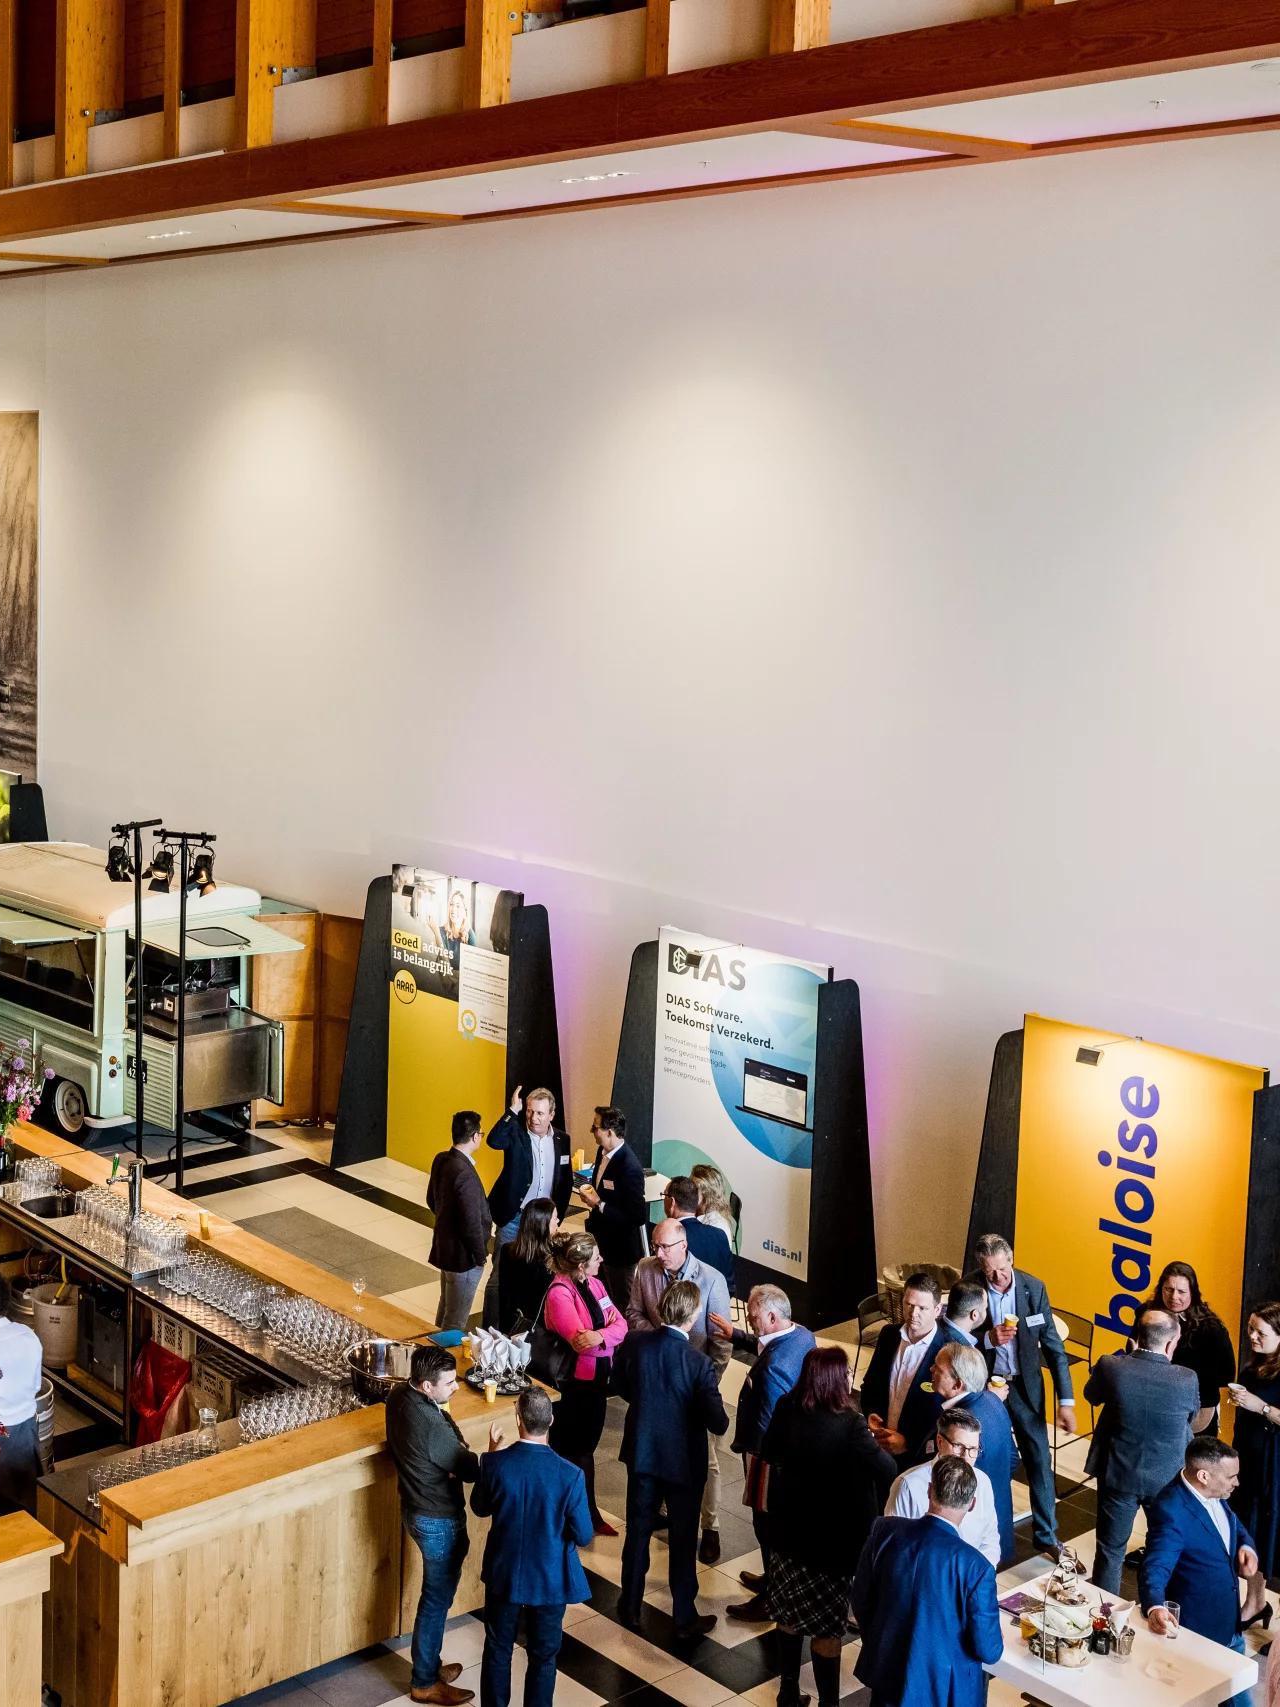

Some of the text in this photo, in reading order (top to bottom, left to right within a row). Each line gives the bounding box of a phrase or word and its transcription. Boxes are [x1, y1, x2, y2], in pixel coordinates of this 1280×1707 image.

[394, 931, 418, 949] Goed
[422, 942, 454, 960] advies
[393, 947, 402, 961] is
[403, 950, 454, 977] belangrijk
[396, 979, 414, 994] ARAG
[666, 993, 744, 1024] DIAS Software.
[665, 1009, 774, 1050] Toekomst Verzekerd.
[1094, 1075, 1161, 1338] baloise
[762, 1239, 802, 1263] dias.nl
